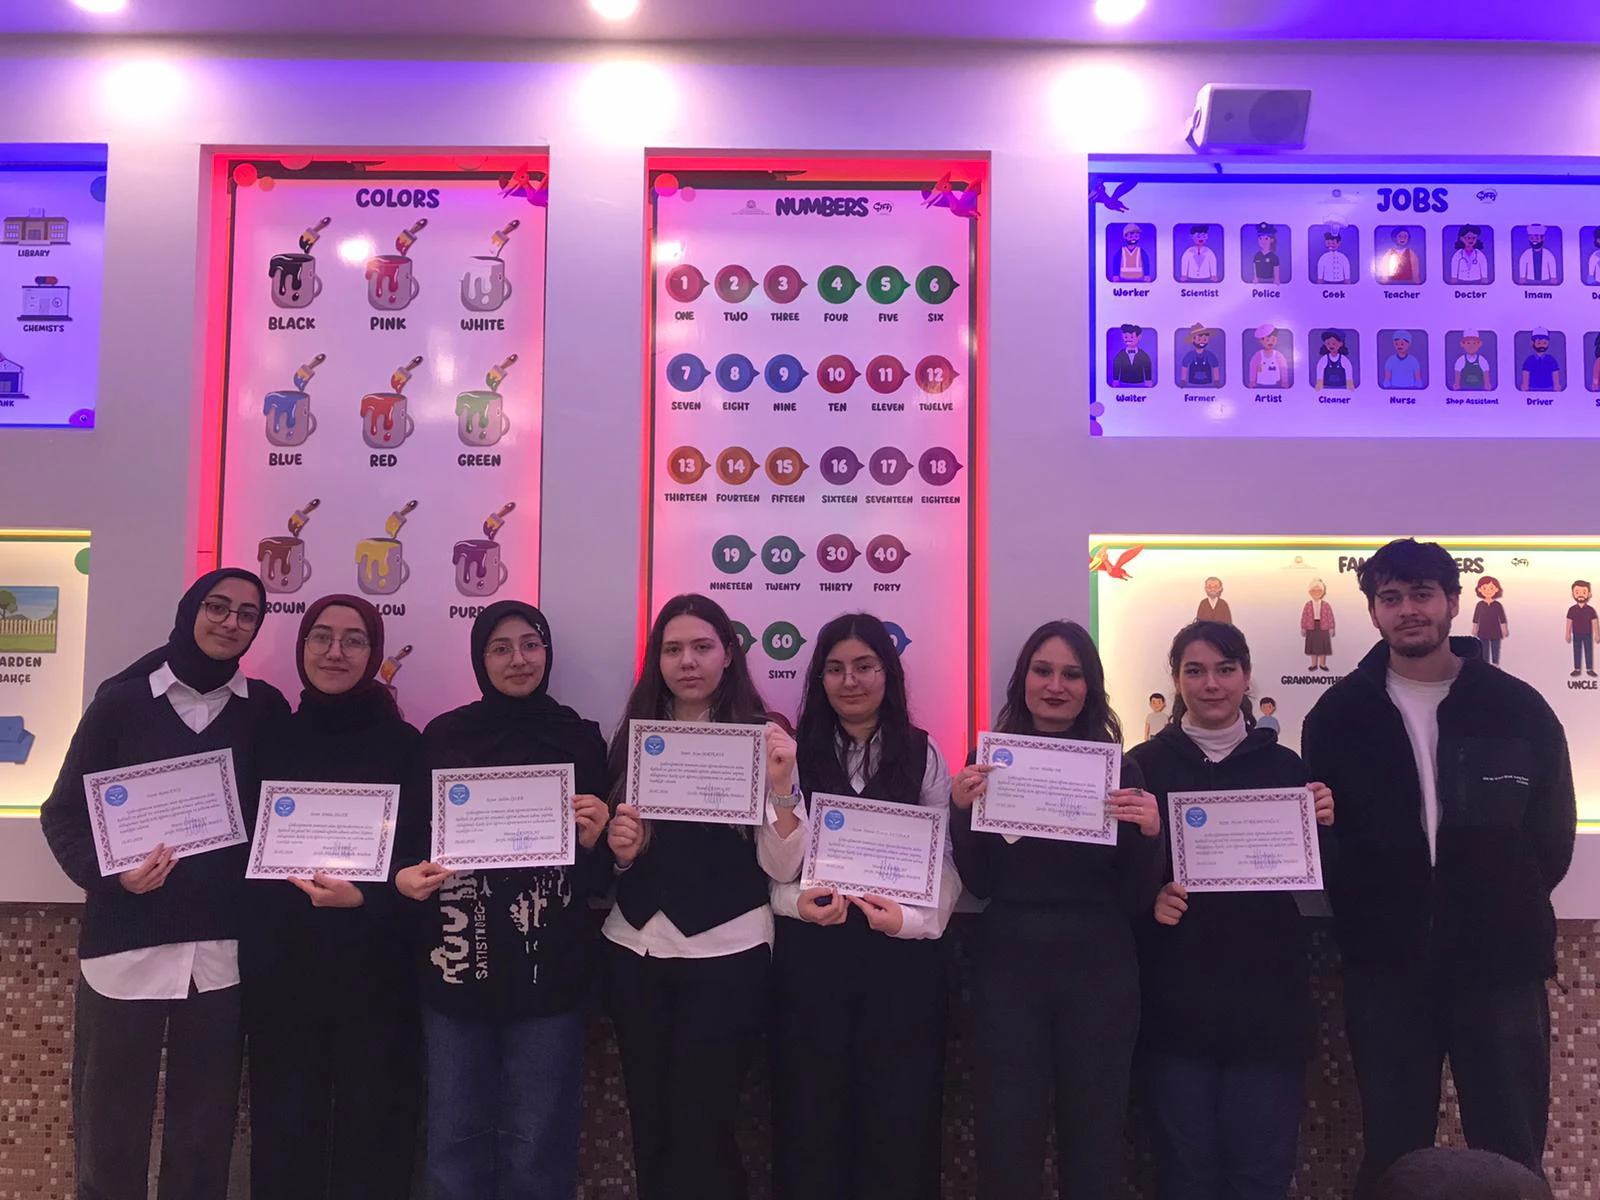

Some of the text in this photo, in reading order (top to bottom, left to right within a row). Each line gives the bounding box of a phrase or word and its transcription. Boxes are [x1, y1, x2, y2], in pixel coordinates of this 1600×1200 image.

[356, 188, 440, 209] COLORS
[1377, 187, 1448, 213] JOBS
[775, 196, 869, 217] NUMBERS
[17, 249, 50, 257] LIBRARY
[680, 276, 688, 289] 1
[729, 276, 739, 290] 2
[778, 277, 788, 290] 3
[832, 277, 842, 291] 4
[880, 277, 891, 291] 5
[930, 278, 939, 292] 6
[1113, 288, 1150, 297] Worker
[1181, 289, 1219, 297] Scientist
[1252, 289, 1280, 298] Police
[1322, 290, 1345, 299] Cook
[1384, 290, 1420, 299] Teacher
[1454, 290, 1487, 299] Doctor
[1524, 291, 1552, 299] Imam
[675, 311, 694, 321] ONE
[724, 312, 748, 321] TWO
[771, 313, 799, 321] THREE
[824, 313, 848, 322] FOUR
[879, 313, 898, 322] FIVE
[928, 313, 944, 322] SIX
[268, 317, 315, 330] BLACK
[370, 317, 406, 330] PINK
[460, 318, 505, 331] WHITE
[681, 366, 691, 380] 7
[730, 367, 739, 380] 8
[779, 367, 788, 381] 9
[827, 368, 845, 381] 10
[879, 368, 893, 381] 11
[927, 369, 943, 381] 12
[1116, 394, 1146, 402] Waiter
[1184, 394, 1215, 402] Farmer
[1255, 394, 1282, 403] Artist
[1318, 396, 1350, 404] Cleaner
[1390, 396, 1416, 405] Nurse
[1526, 397, 1553, 406] Driver
[672, 402, 701, 410] SEVEN
[723, 402, 750, 411] EIGHT
[773, 403, 797, 411] NINE
[828, 403, 847, 412] TEN
[872, 403, 904, 412] ELEVEN
[919, 403, 953, 412] TWELVE
[268, 453, 302, 466] BLUE
[370, 454, 397, 467] RED
[458, 454, 501, 467] GREEN
[678, 459, 695, 472] 13
[726, 459, 745, 473] 14
[776, 459, 793, 473] 15
[831, 459, 847, 473] 16
[880, 460, 897, 473] 17
[930, 460, 947, 473] 18
[664, 493, 707, 502] THIRTEEN
[716, 494, 760, 502] FOURTEEN
[772, 494, 805, 503] FIFTEEN
[822, 495, 857, 504] SIXTEEN
[866, 496, 913, 504] SEVENTEEN
[921, 496, 960, 504] EIGHTEEN
[723, 548, 740, 562] 19
[771, 548, 791, 562] 20
[826, 547, 847, 561] 30
[875, 547, 897, 561] 40
[710, 582, 752, 591] NINETEEN
[765, 583, 800, 591] TWENTY
[819, 583, 852, 591] THIRTY
[874, 583, 901, 592] FORTY
[265, 602, 305, 614] ROWN
[376, 604, 405, 616] LOW
[772, 634, 792, 648] 60
[0, 656, 42, 667] ARDEN
[769, 670, 796, 680] SIXTY
[1567, 680, 1597, 690] UNCLE
